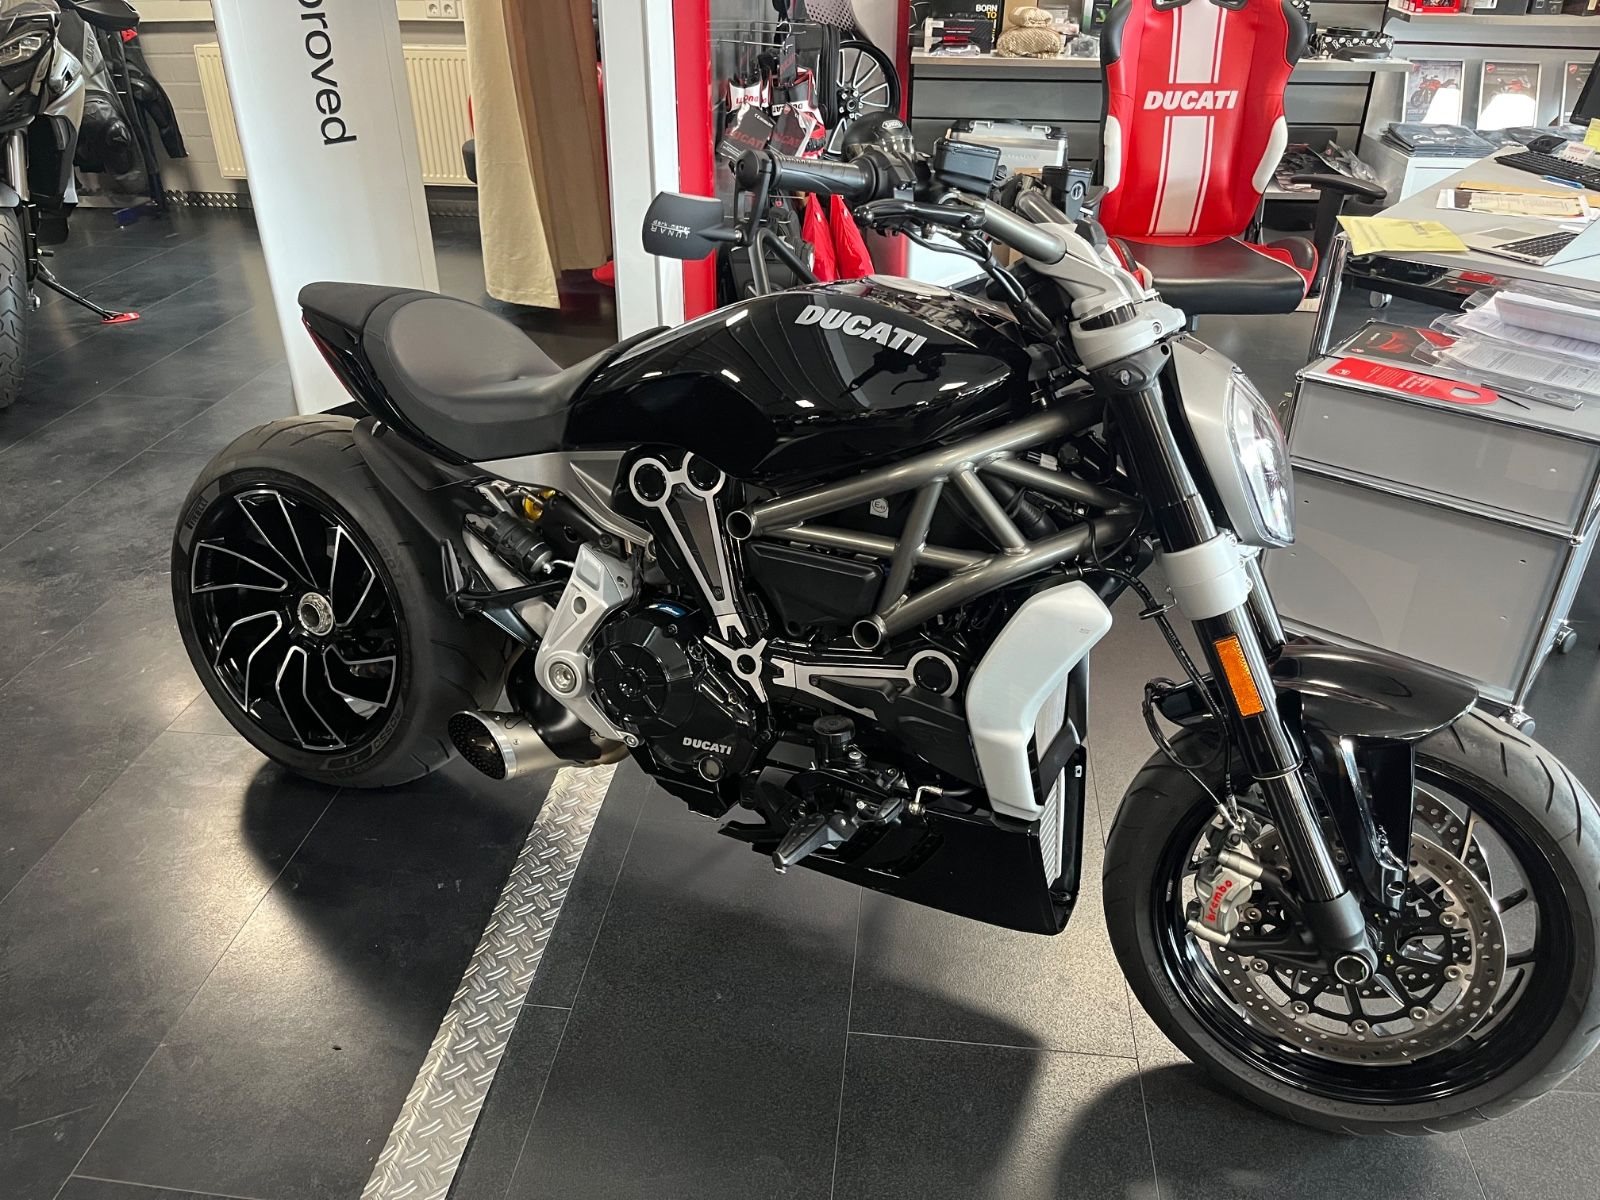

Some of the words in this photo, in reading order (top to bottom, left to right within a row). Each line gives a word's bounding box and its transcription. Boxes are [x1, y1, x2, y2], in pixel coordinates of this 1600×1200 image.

[975, 4, 998, 12] BORN
[986, 11, 997, 19] TO
[298, 0, 357, 145] roved
[1143, 90, 1239, 110] DUCATI
[795, 304, 928, 356] DUCATI
[682, 736, 732, 755] DUCATI
[1205, 880, 1233, 922] brembo
